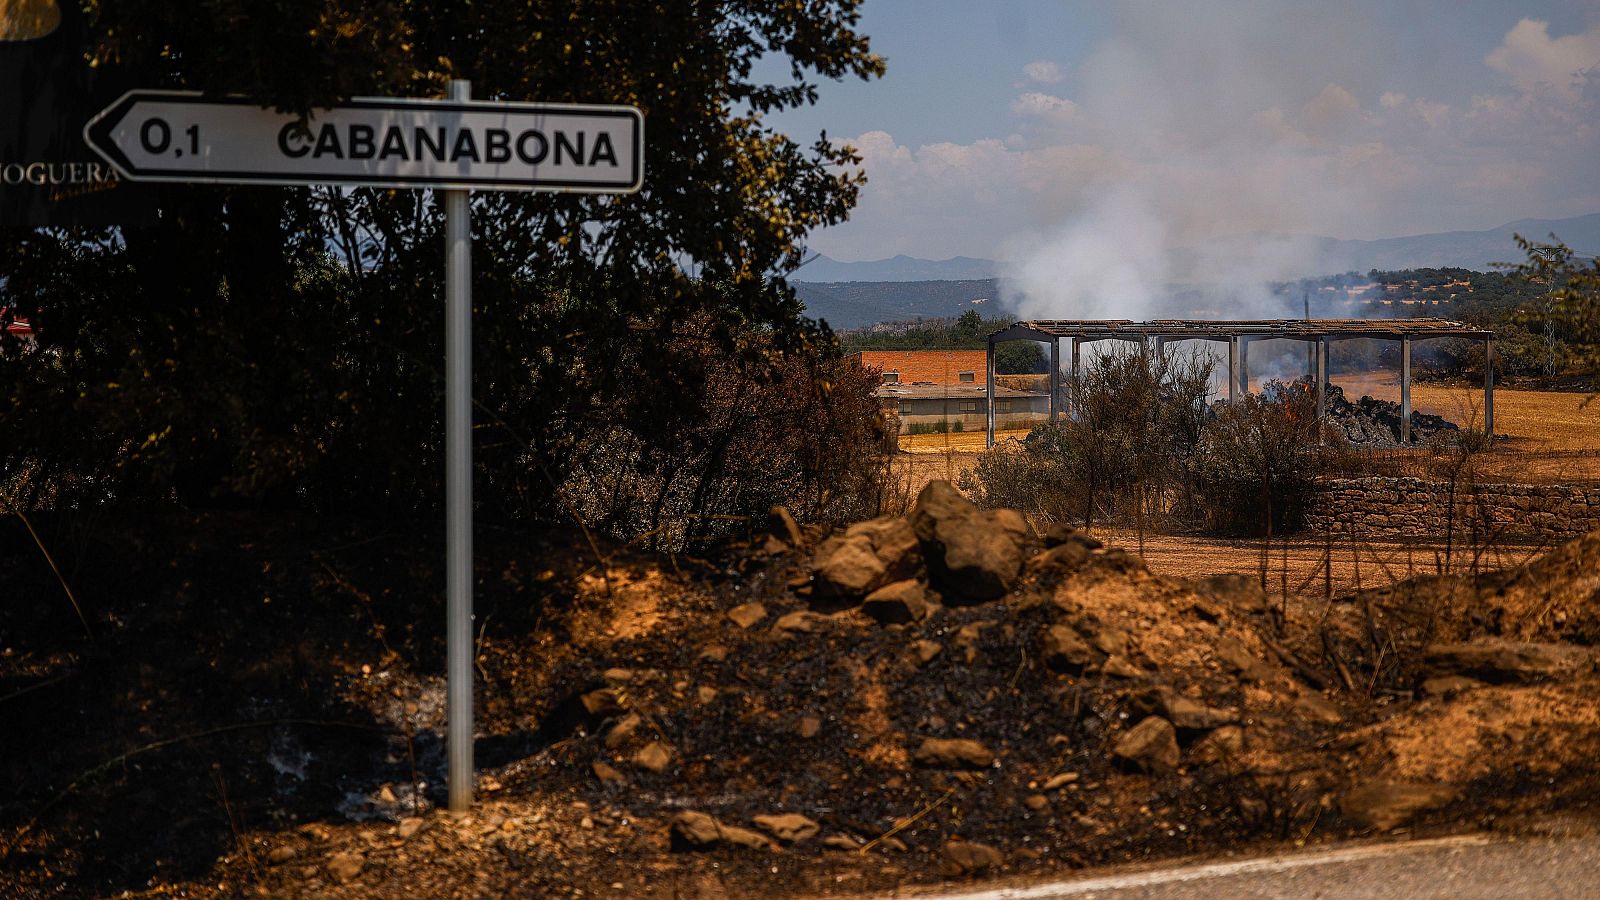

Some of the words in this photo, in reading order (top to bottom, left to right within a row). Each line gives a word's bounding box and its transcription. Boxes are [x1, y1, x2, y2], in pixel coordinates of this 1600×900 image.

[140, 118, 199, 158] 0,1
[278, 121, 617, 167] CABANABONA
[0, 162, 120, 185] OGUERA
